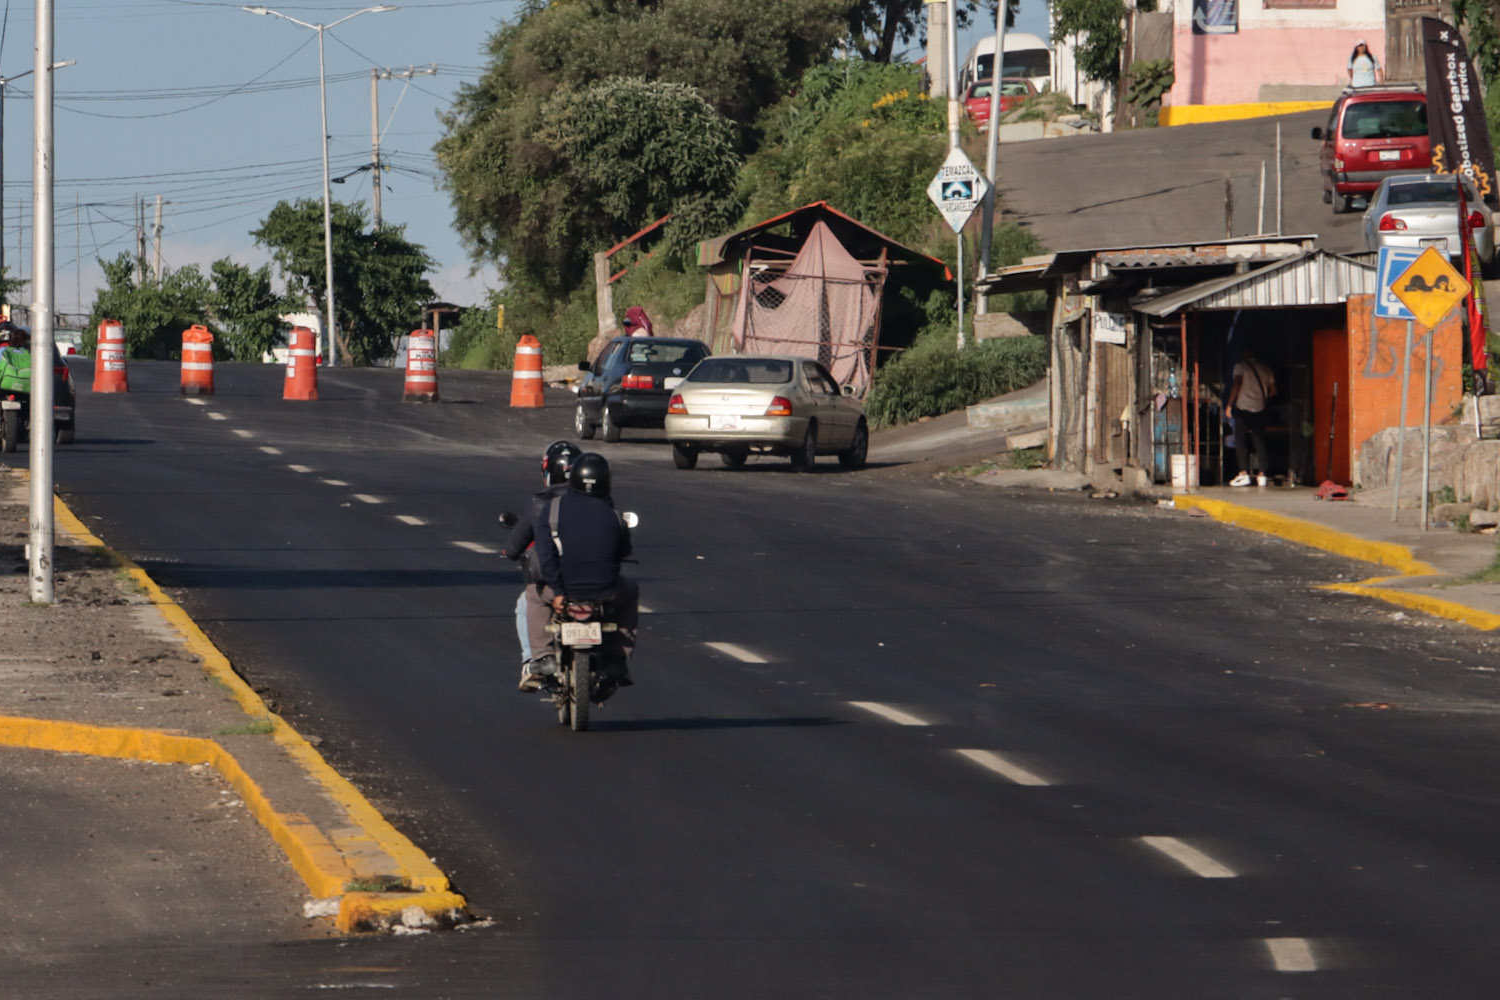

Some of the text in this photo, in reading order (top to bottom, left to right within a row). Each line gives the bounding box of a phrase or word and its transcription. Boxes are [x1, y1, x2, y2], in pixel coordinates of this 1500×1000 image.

[1446, 52, 1464, 114] Gearbox
[1456, 61, 1470, 102] Service
[942, 165, 974, 177] TEMAZCAL
[1451, 115, 1476, 182] obotized
